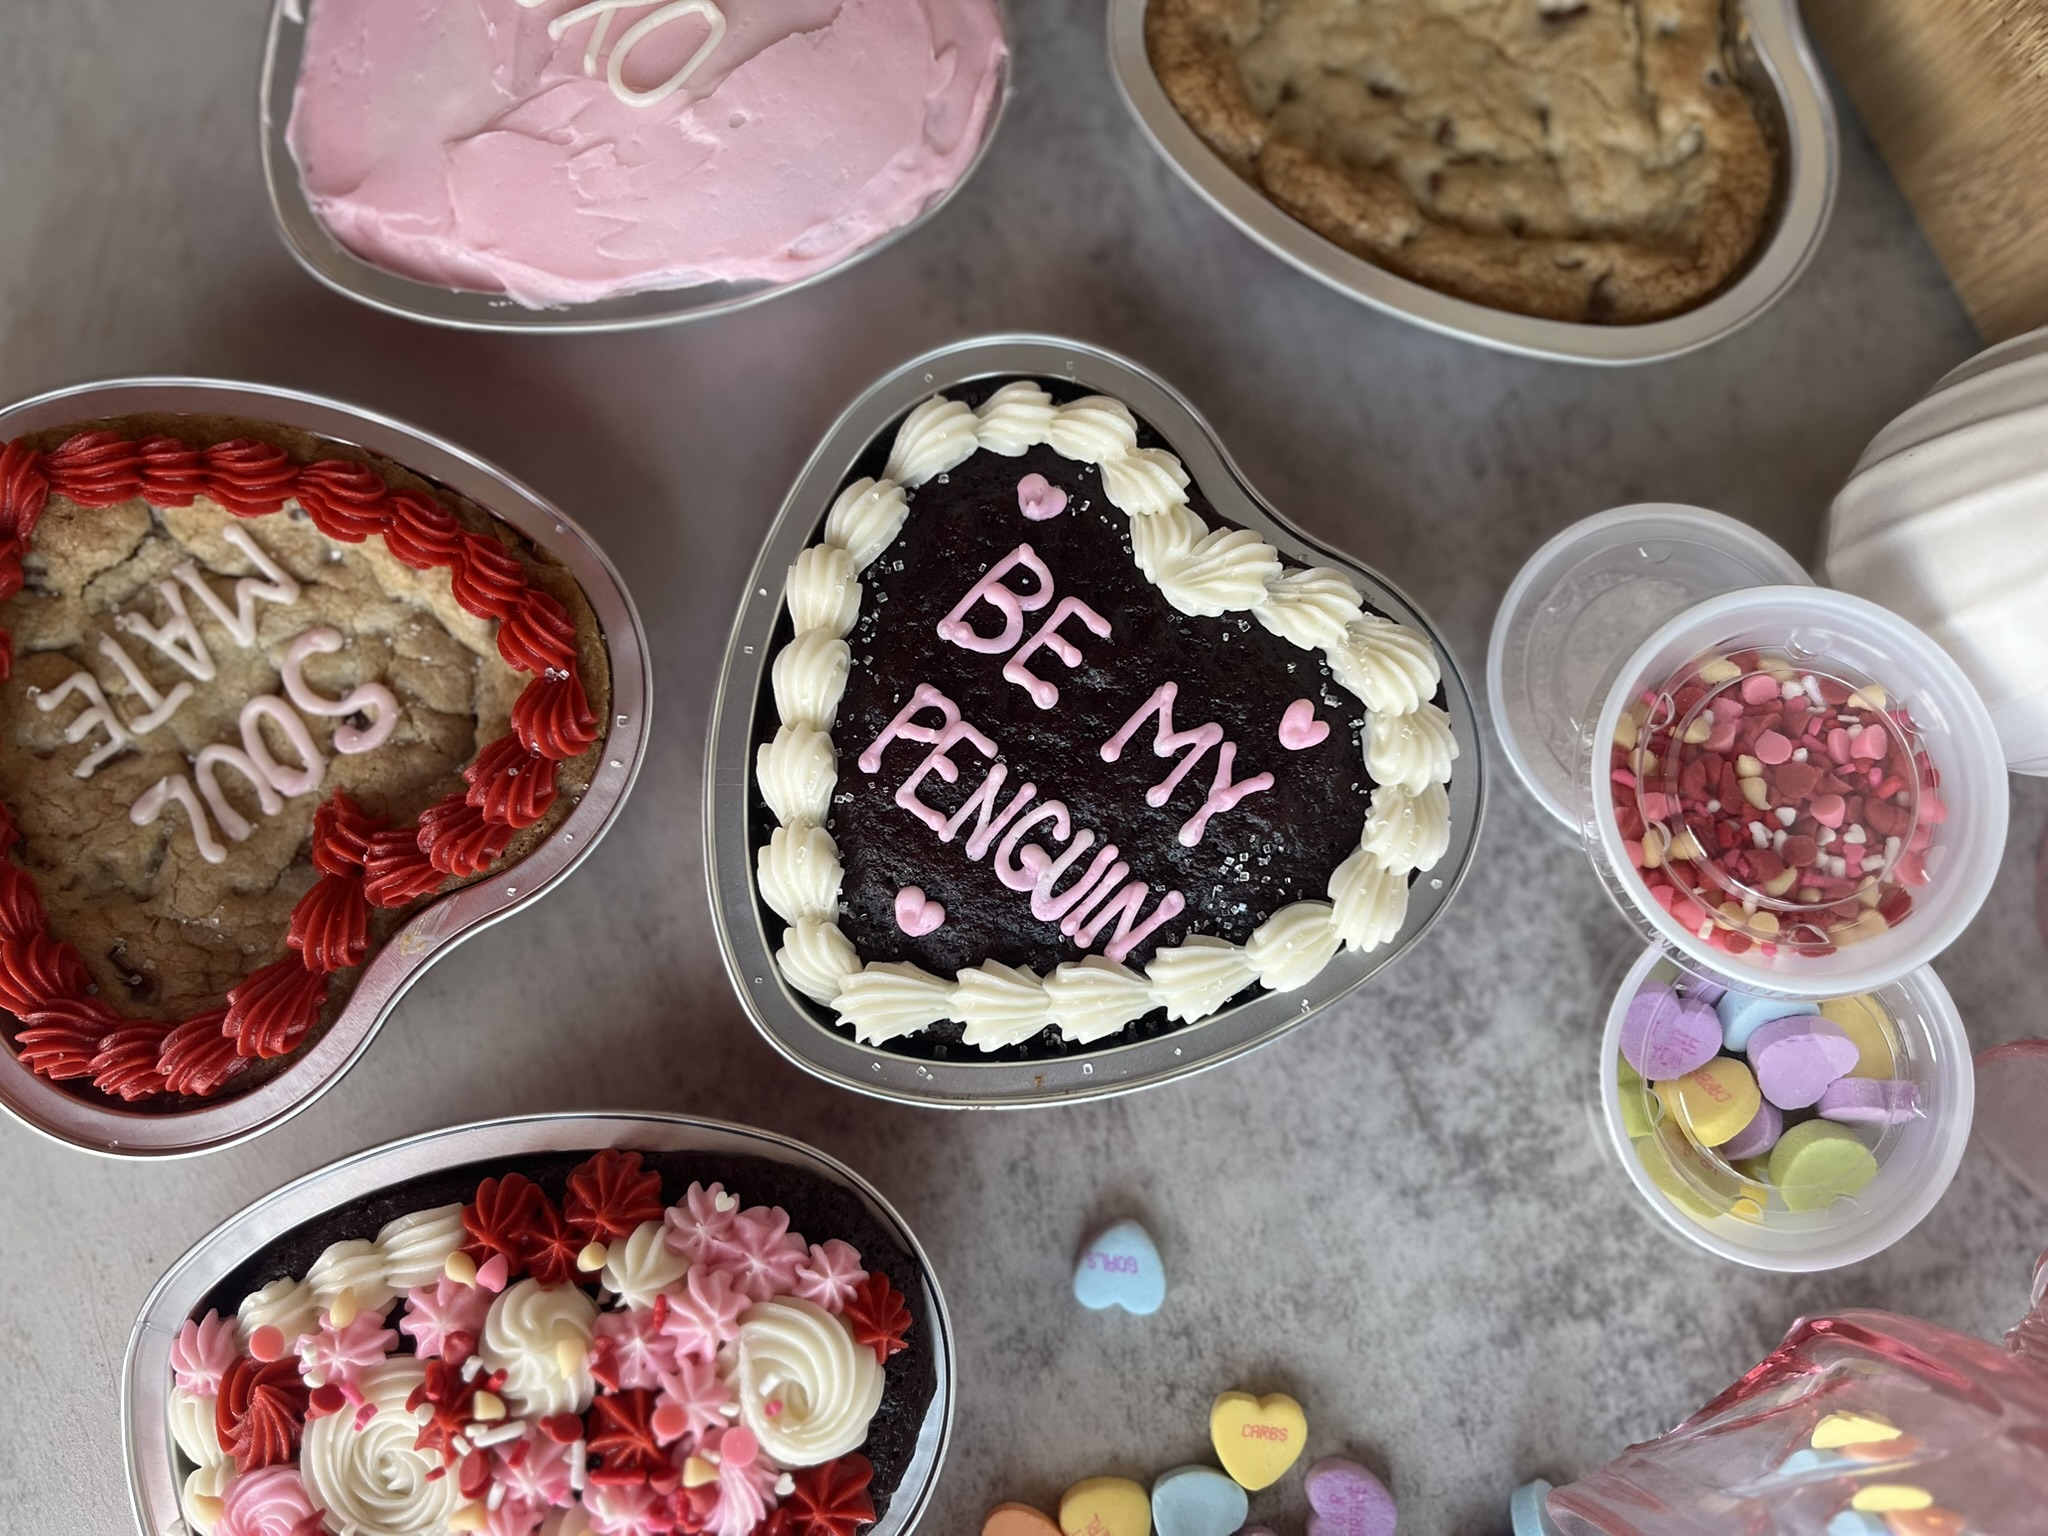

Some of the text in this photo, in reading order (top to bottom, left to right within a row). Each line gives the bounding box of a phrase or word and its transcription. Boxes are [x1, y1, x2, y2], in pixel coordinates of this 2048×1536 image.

[36, 522, 299, 779] MATE
[129, 626, 399, 864] SOUL
[936, 542, 1275, 847] BE MY
[857, 682, 1186, 963] PENGUIN
[1086, 1251, 1138, 1275] GOALS
[1241, 1423, 1289, 1442] CARBS
